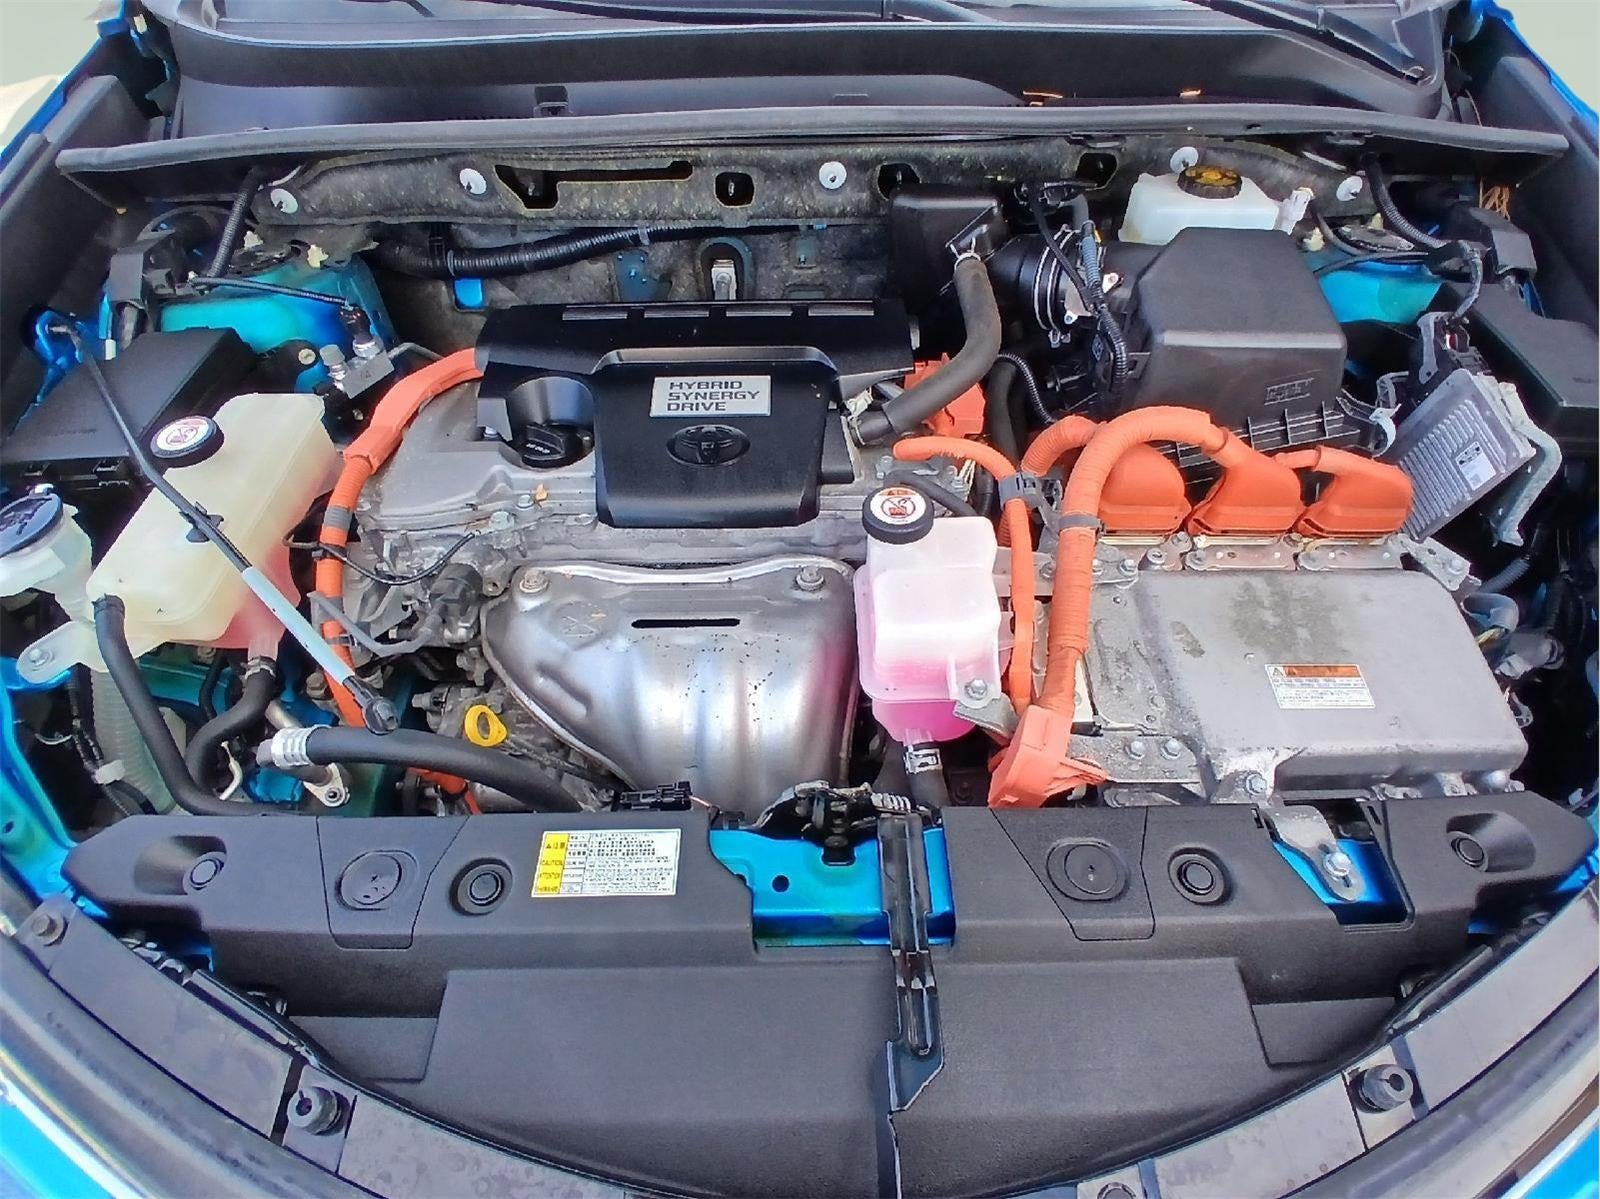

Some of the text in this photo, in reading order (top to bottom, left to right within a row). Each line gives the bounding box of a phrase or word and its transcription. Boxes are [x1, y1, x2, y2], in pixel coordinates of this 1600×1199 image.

[669, 380, 743, 390] HYBRID
[667, 390, 760, 401] SYNERGY
[667, 402, 726, 412] DRIVE
